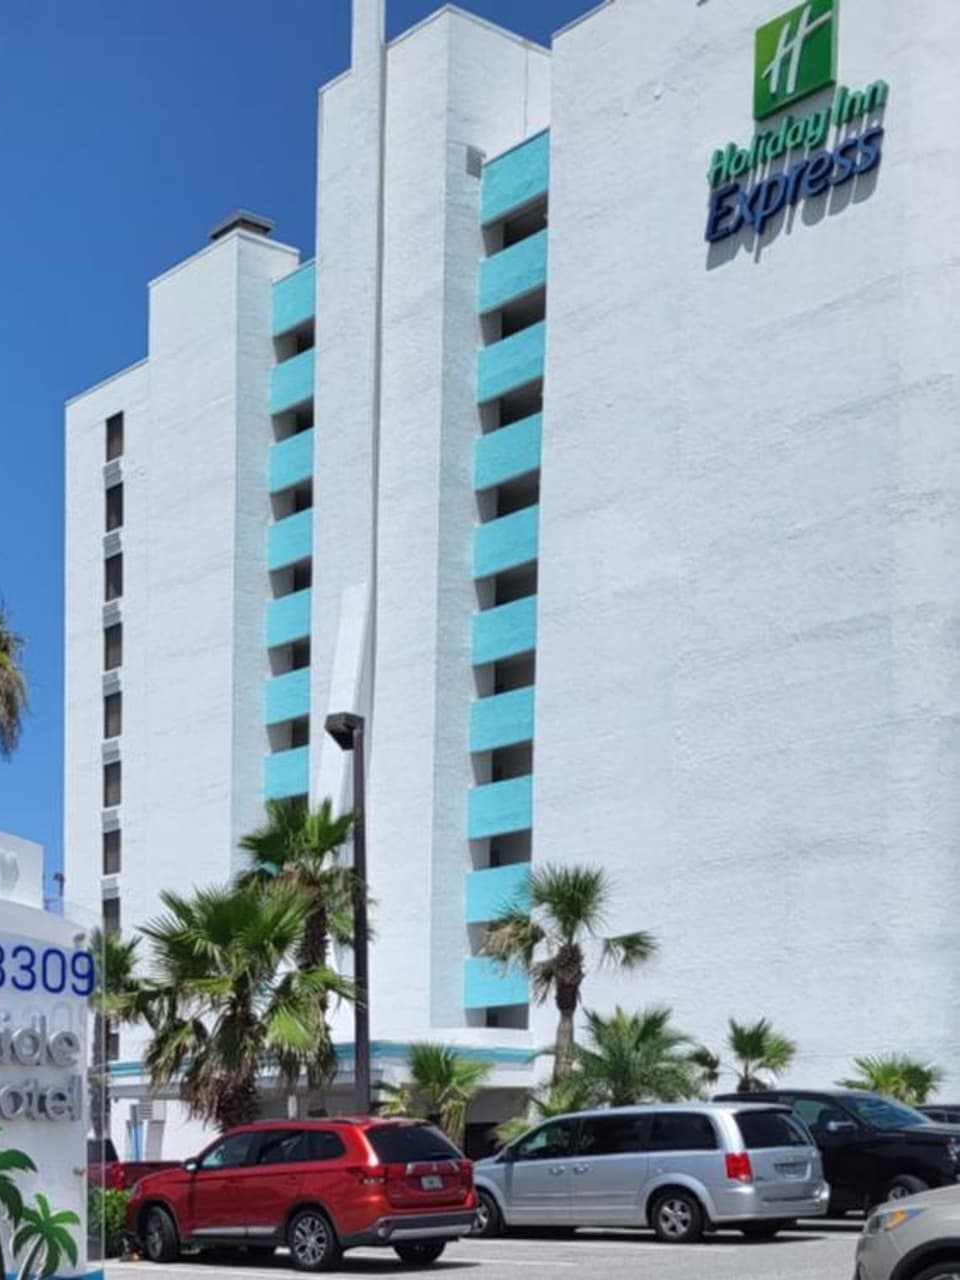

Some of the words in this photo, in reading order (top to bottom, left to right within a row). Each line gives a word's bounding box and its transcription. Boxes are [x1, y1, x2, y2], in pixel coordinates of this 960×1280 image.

[705, 126, 885, 242] Express
[707, 107, 832, 187] Holiday
[833, 79, 889, 127] Inn
